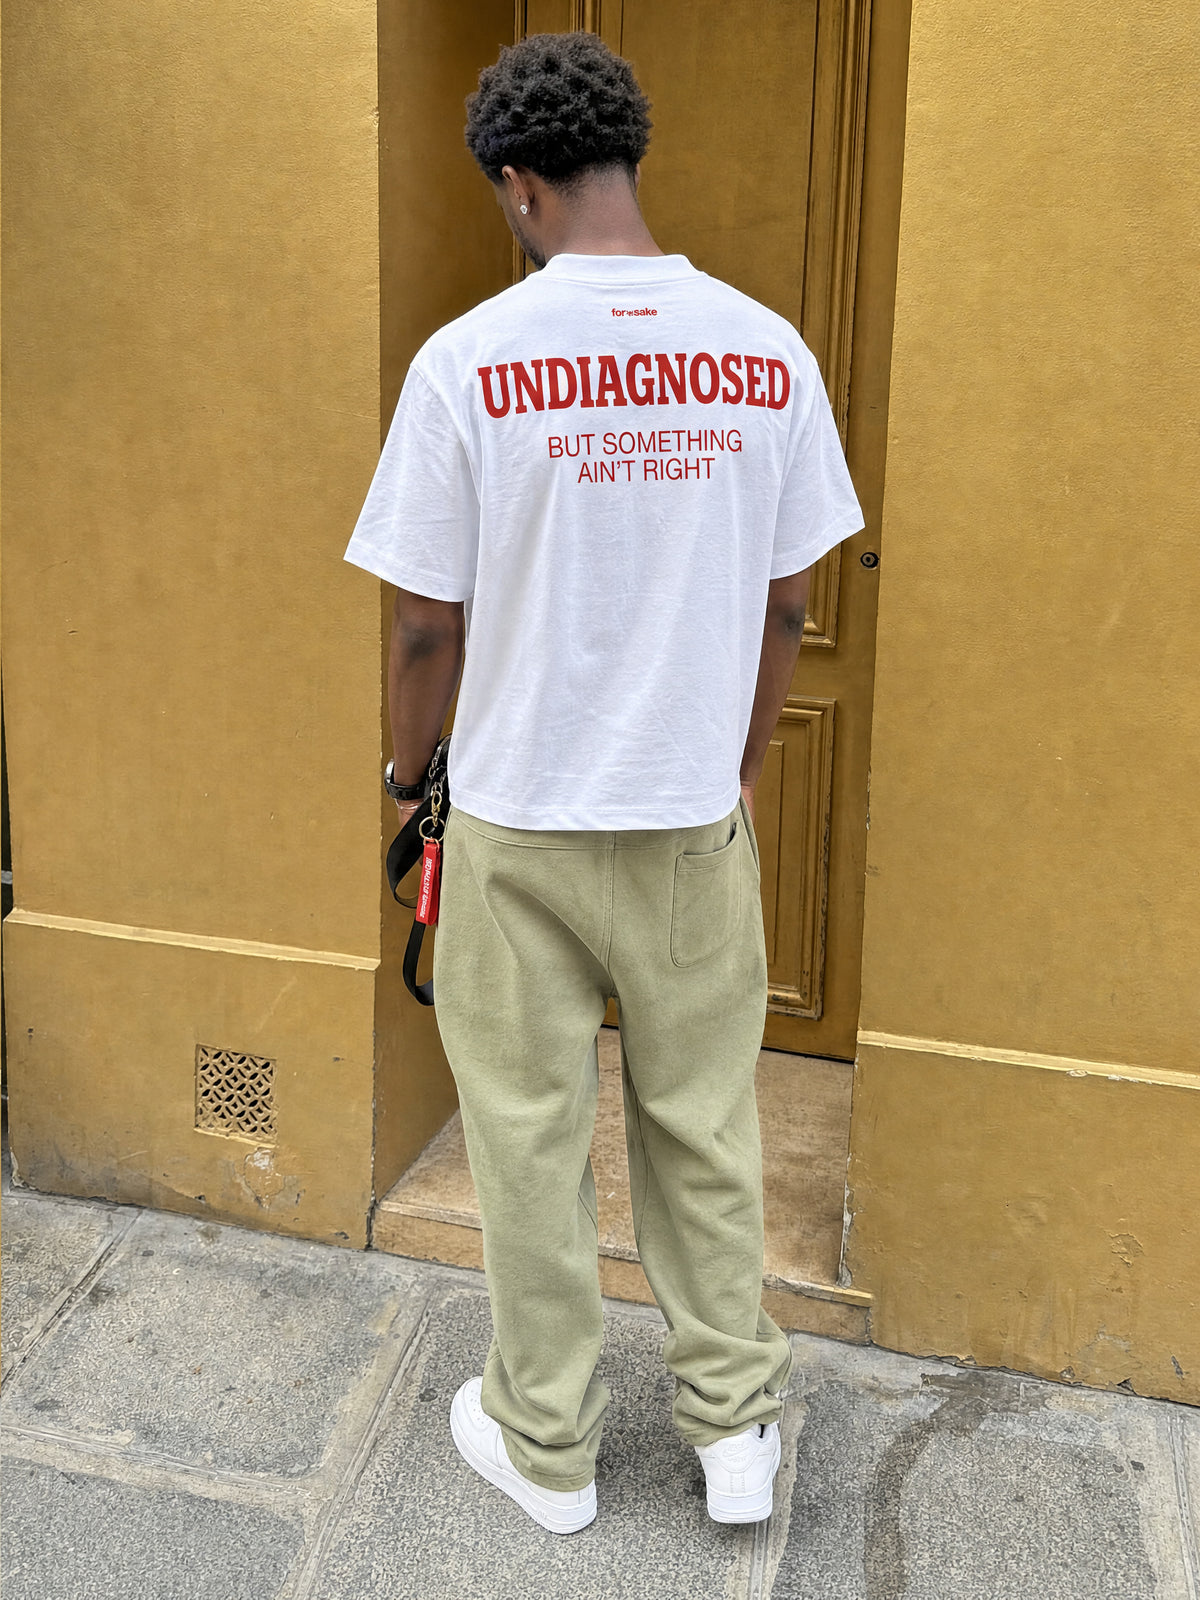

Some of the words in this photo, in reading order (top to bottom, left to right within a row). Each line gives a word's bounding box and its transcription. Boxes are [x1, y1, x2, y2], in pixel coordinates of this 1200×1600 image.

[477, 352, 791, 418] UNDIAGNOSED
[548, 434, 595, 459] BUT
[602, 429, 743, 455] SOMETHING
[577, 460, 636, 484] AIN’T
[643, 457, 716, 481] RIGHT
